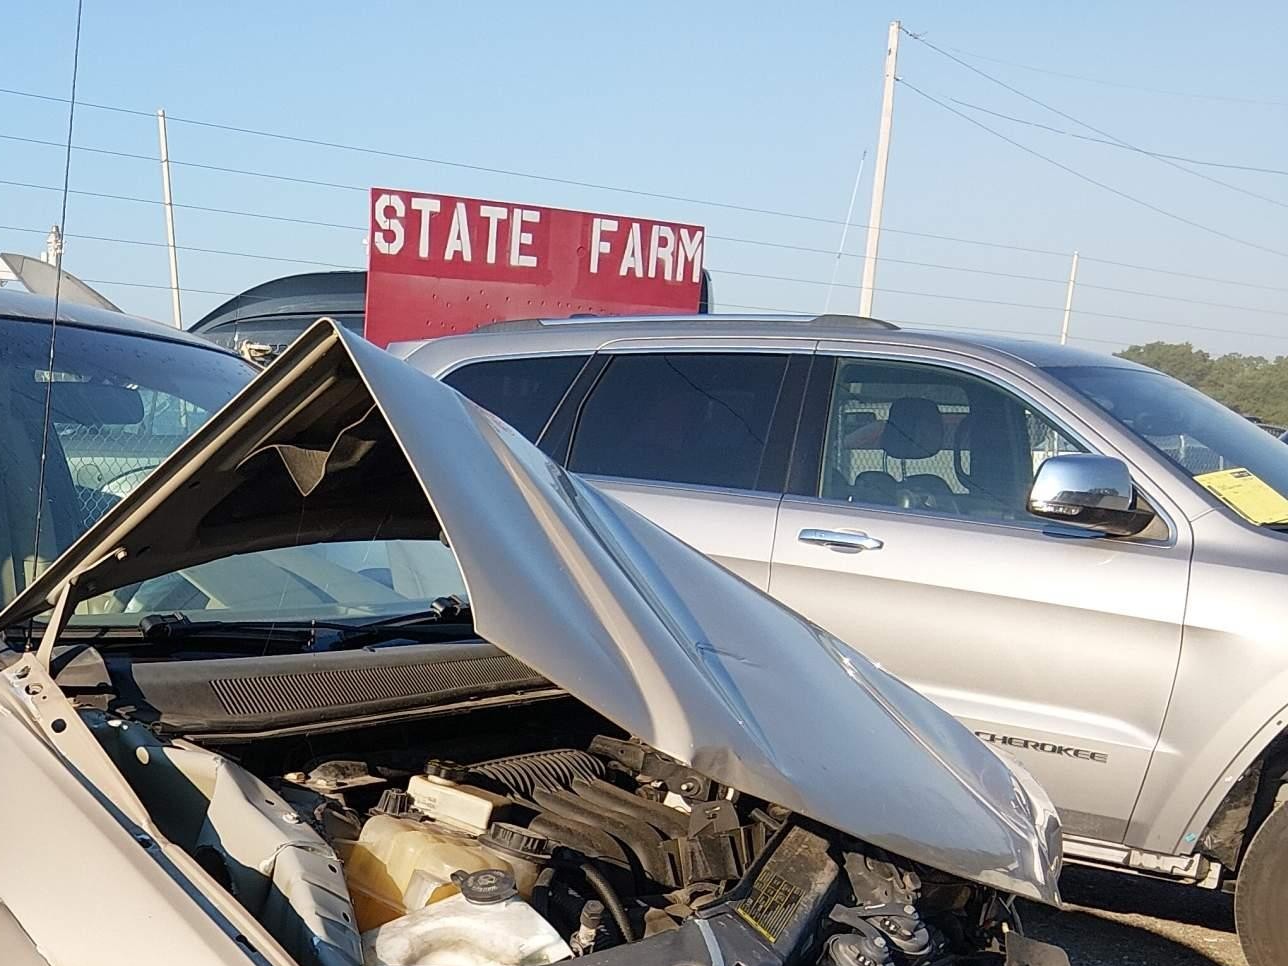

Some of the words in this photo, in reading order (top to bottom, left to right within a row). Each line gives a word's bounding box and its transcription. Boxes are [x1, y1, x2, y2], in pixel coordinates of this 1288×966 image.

[374, 193, 541, 268] STATE
[589, 217, 703, 284] FARM
[975, 730, 1108, 763] CHEROKEE
